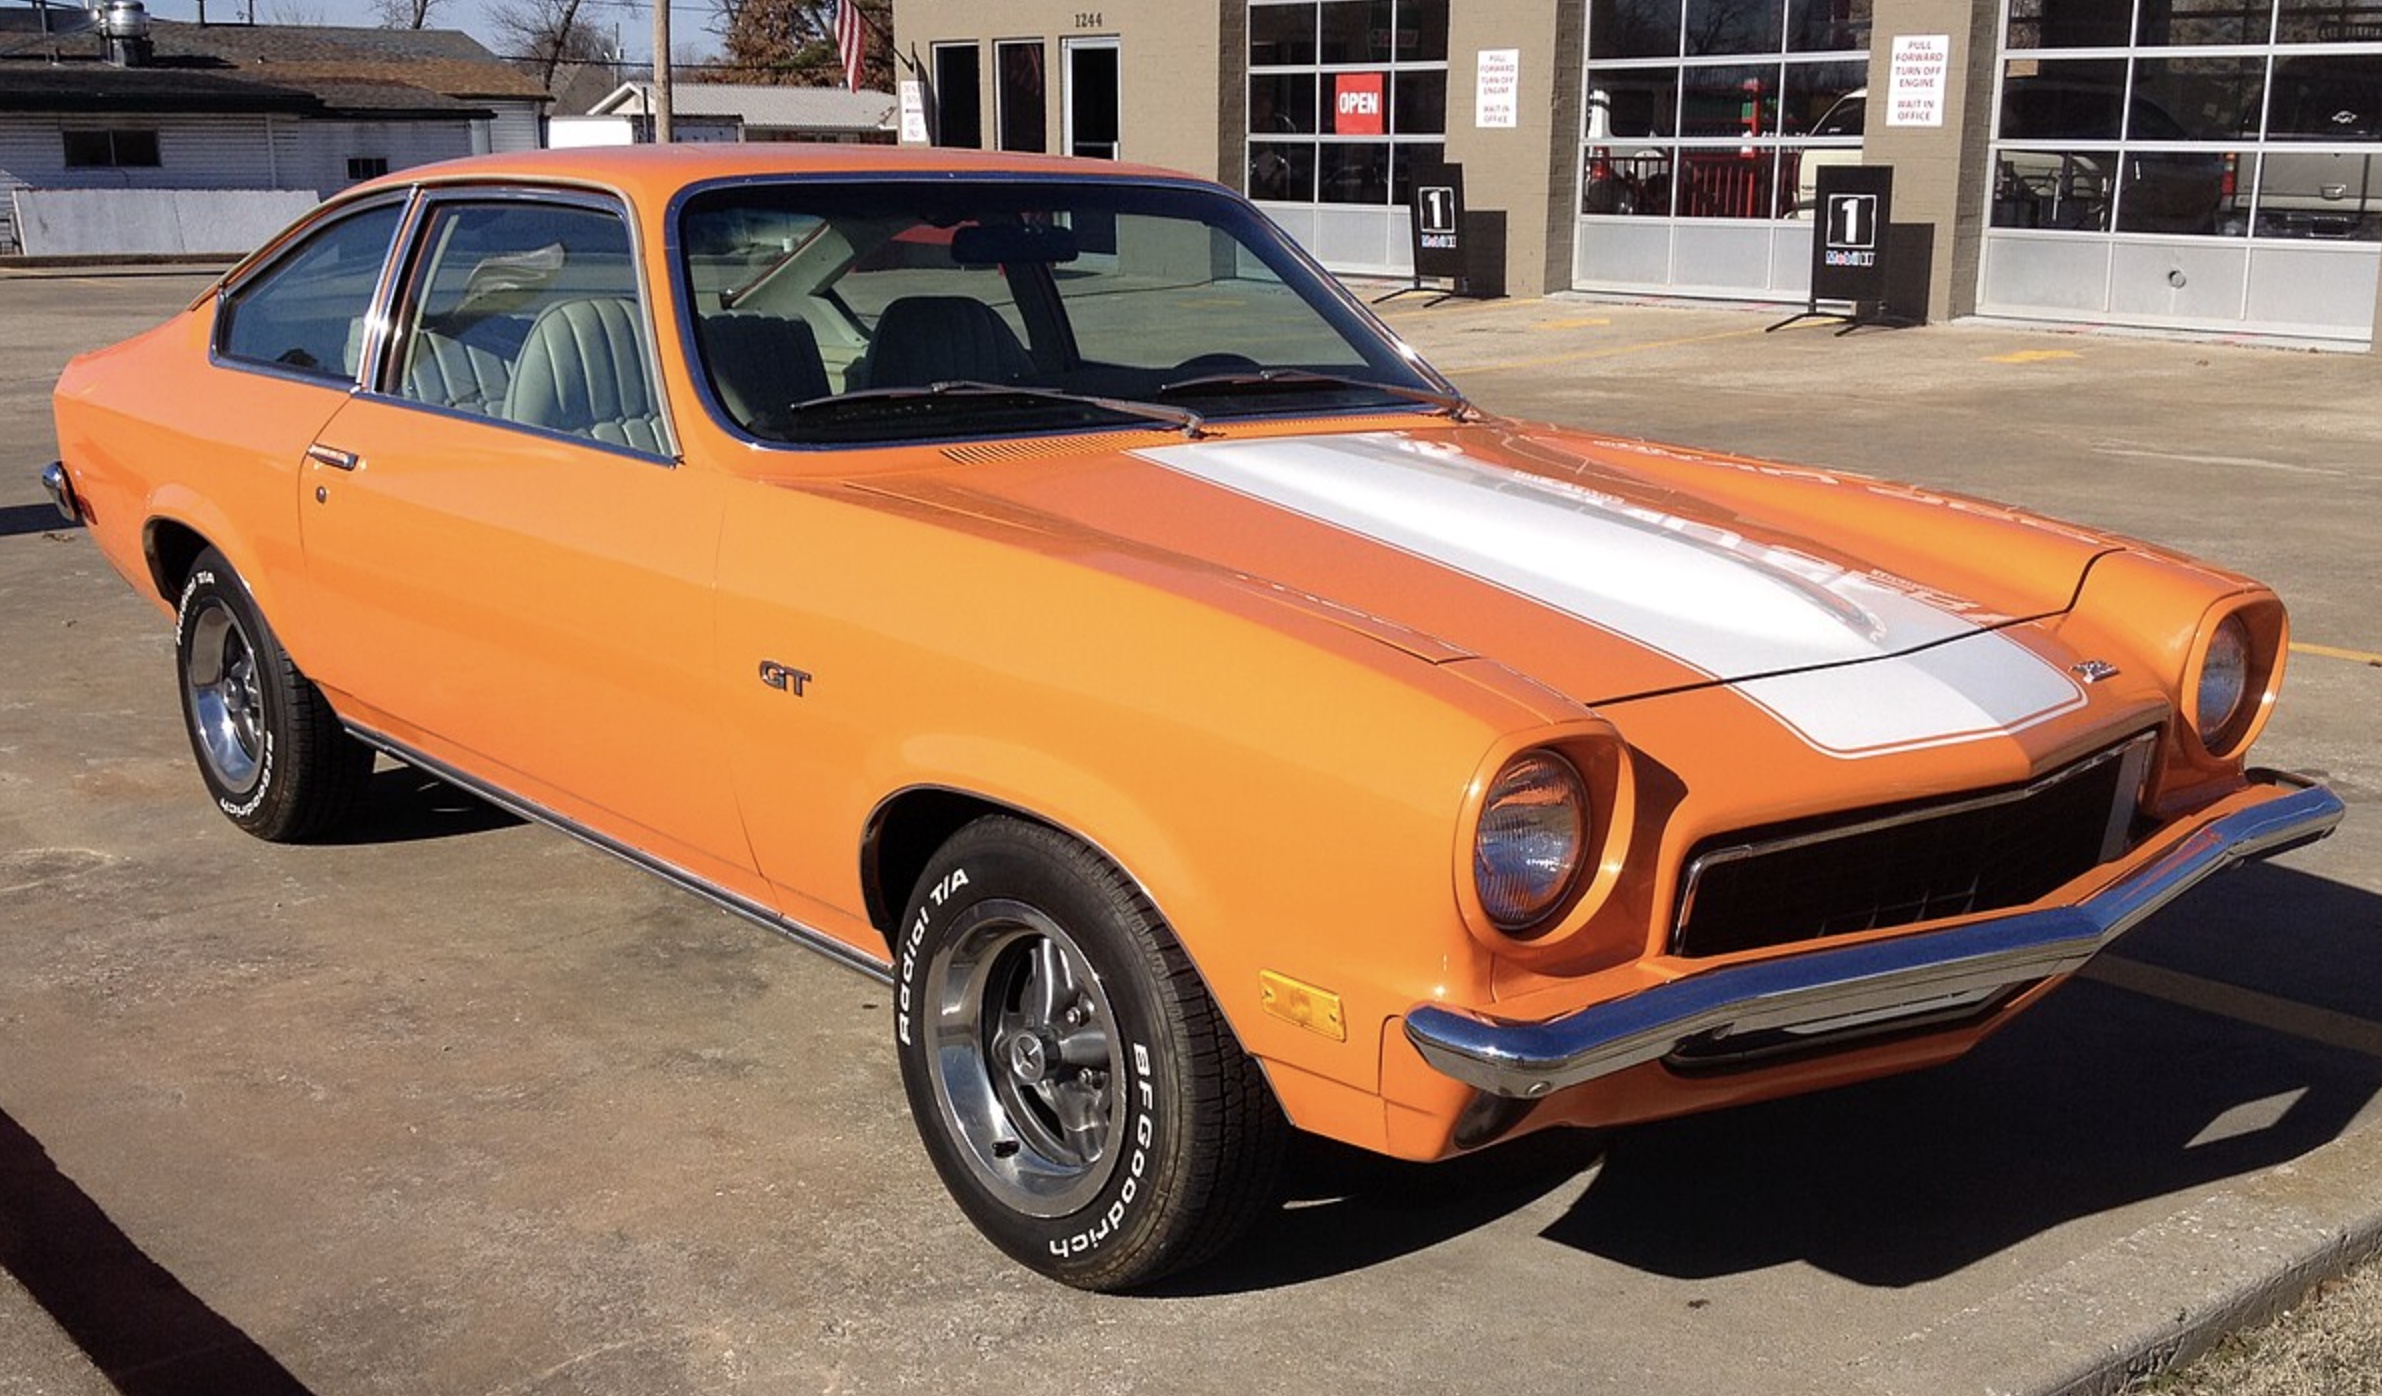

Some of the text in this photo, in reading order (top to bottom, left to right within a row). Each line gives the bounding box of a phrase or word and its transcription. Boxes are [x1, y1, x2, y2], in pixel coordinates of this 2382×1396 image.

[1075, 12, 1102, 28] 1244
[1908, 41, 1931, 50] PULL
[1895, 52, 1943, 62] FORWARD
[1896, 66, 1941, 76] TURN OFF
[1899, 78, 1934, 88] ENGINE
[1339, 91, 1379, 115] OPEN
[1897, 99, 1935, 109] WAIT IN
[1897, 110, 1931, 122] OFFICE
[1428, 190, 1442, 228] 1
[1841, 198, 1858, 243] 1
[759, 659, 812, 698] GT
[899, 867, 970, 1046] Radial T/A
[1049, 1042, 1154, 1258] BFGoodrich
